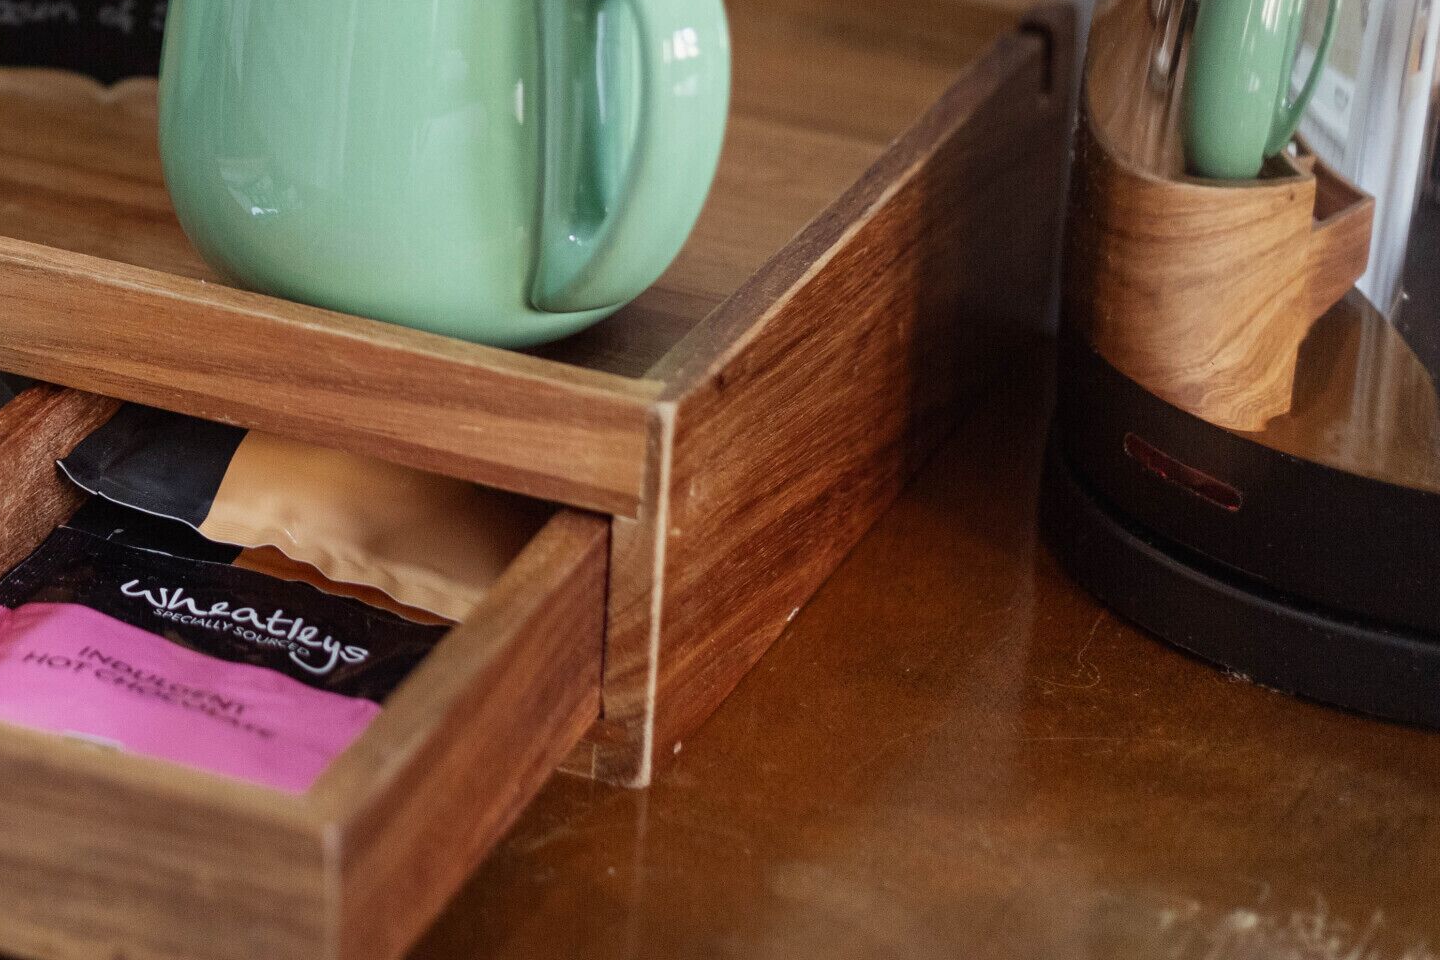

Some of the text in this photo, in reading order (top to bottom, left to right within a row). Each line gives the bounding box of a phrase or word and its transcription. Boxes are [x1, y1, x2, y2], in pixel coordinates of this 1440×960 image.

[120, 577, 370, 676] Wheatleys
[152, 607, 311, 657] SPECIALLY SOURCED
[23, 650, 94, 673] HOT
